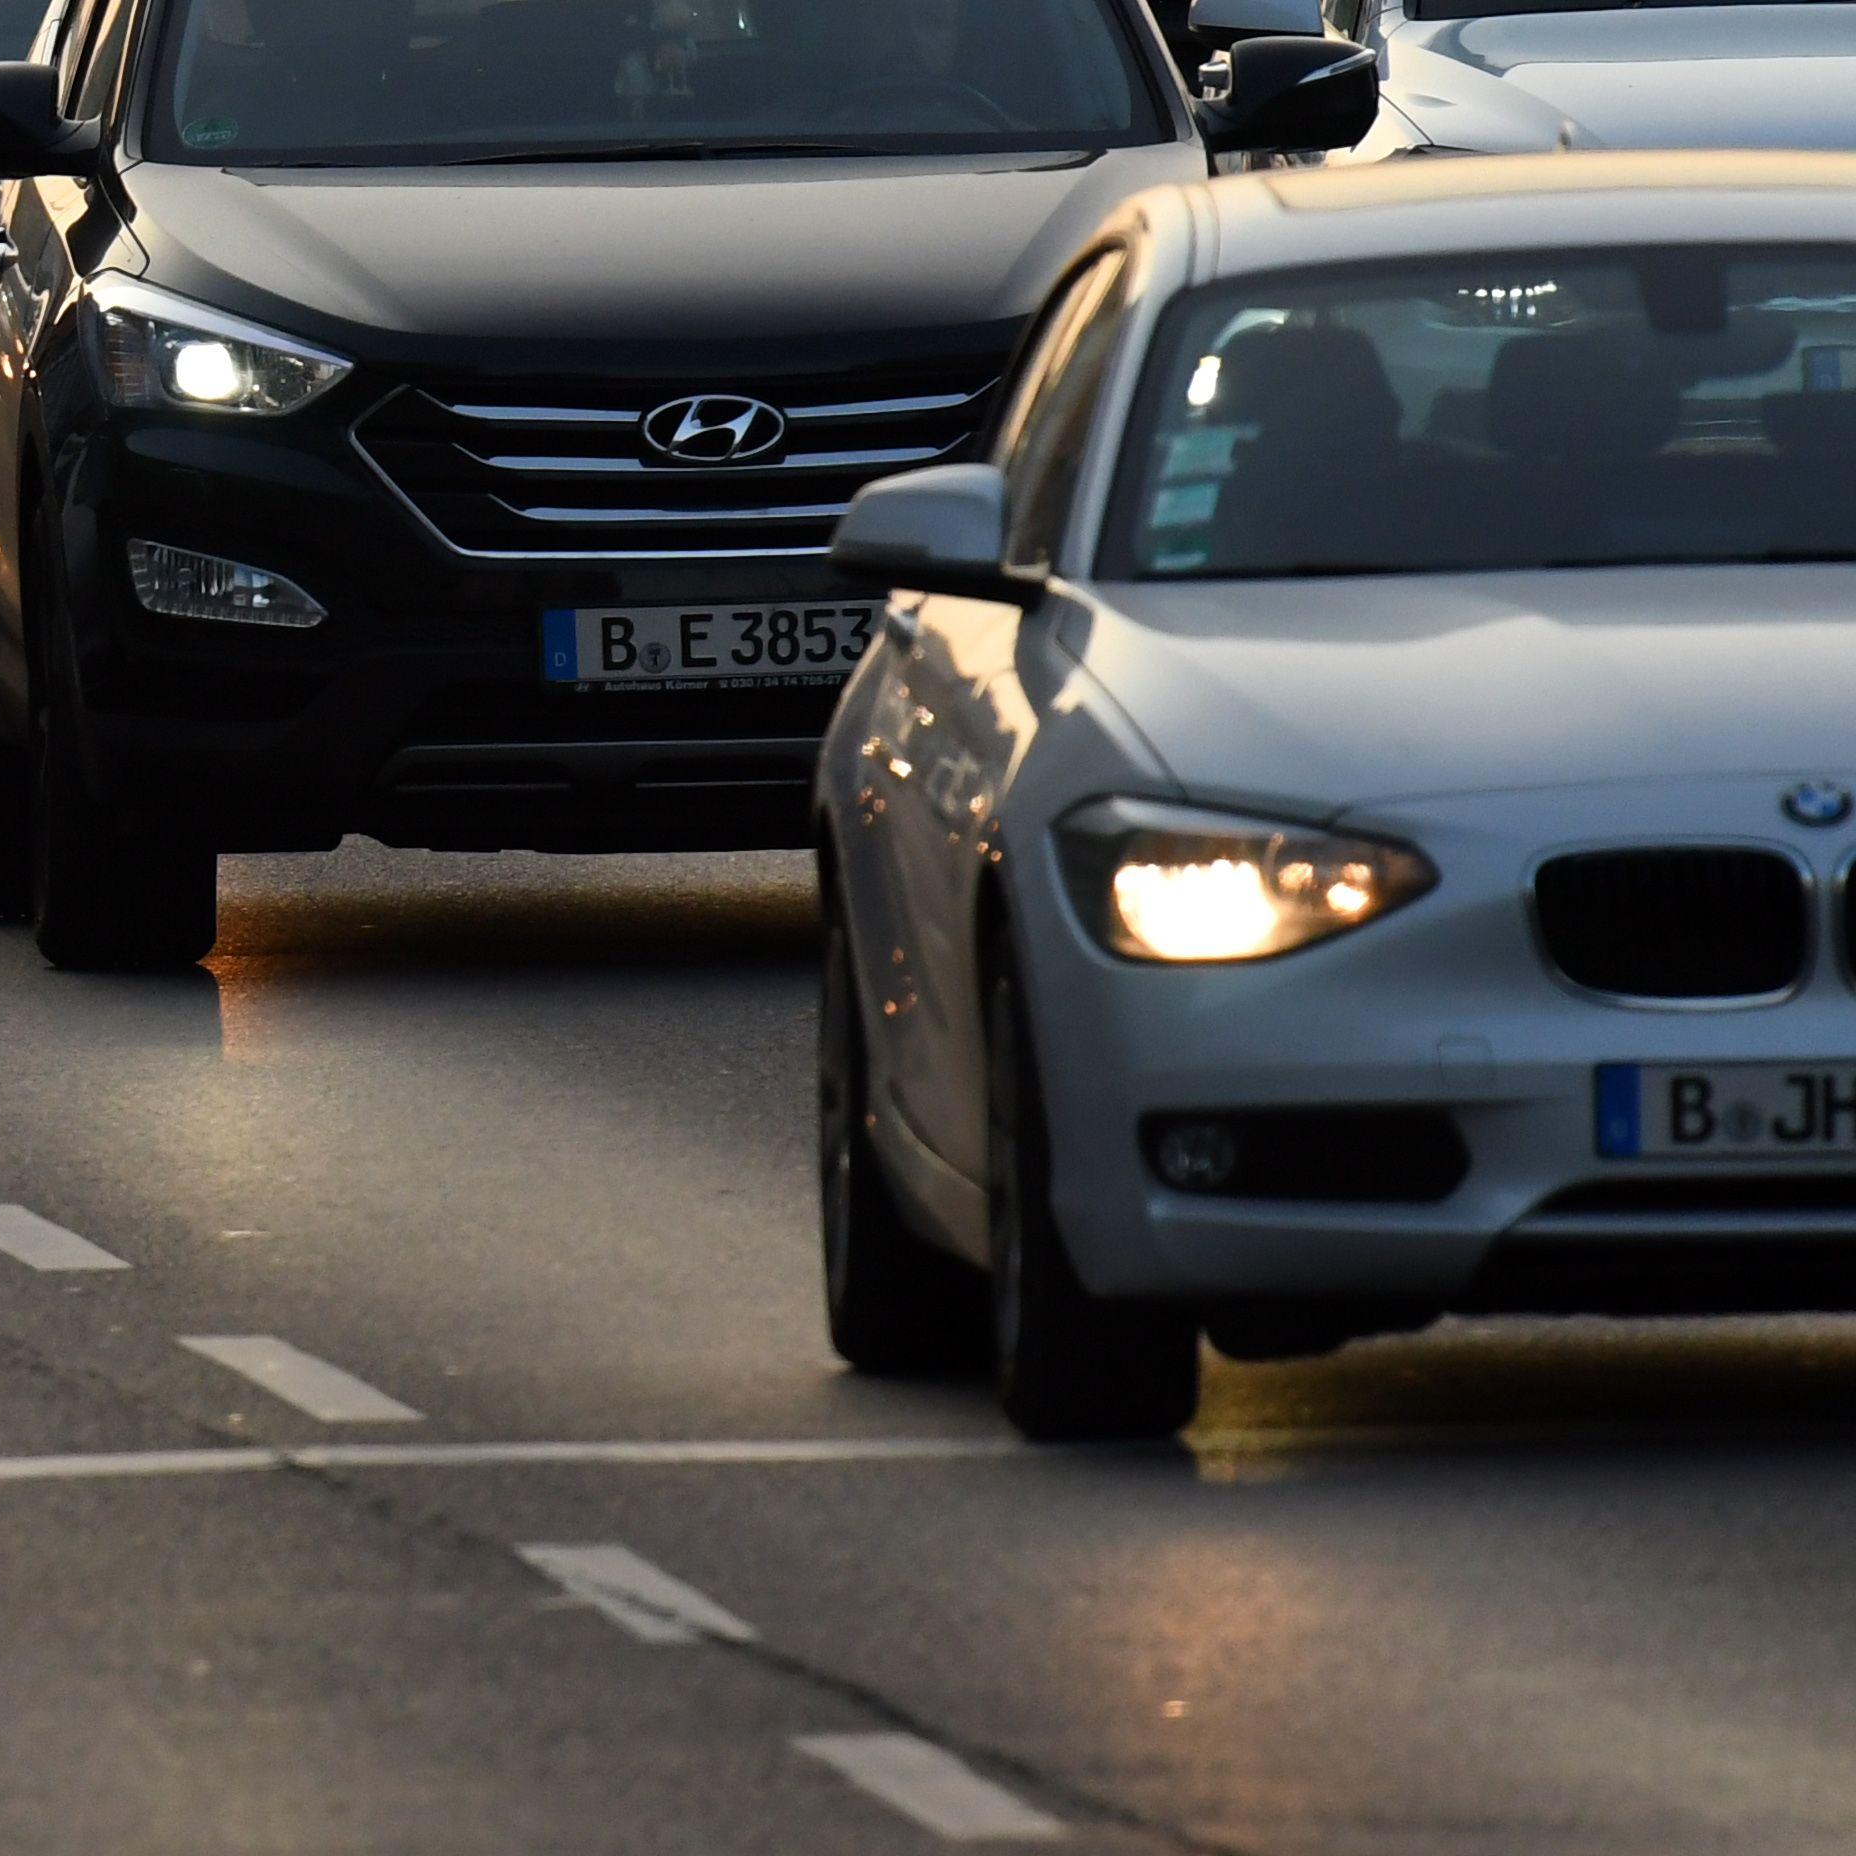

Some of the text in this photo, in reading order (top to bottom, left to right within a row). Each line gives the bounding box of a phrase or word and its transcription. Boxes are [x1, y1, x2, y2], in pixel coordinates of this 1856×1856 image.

[601, 616, 638, 672] B
[680, 613, 717, 669] E
[731, 607, 872, 666] 3853
[603, 680, 663, 692] Autohaus
[665, 679, 709, 691] Körner
[1670, 1073, 1856, 1143] B JH
